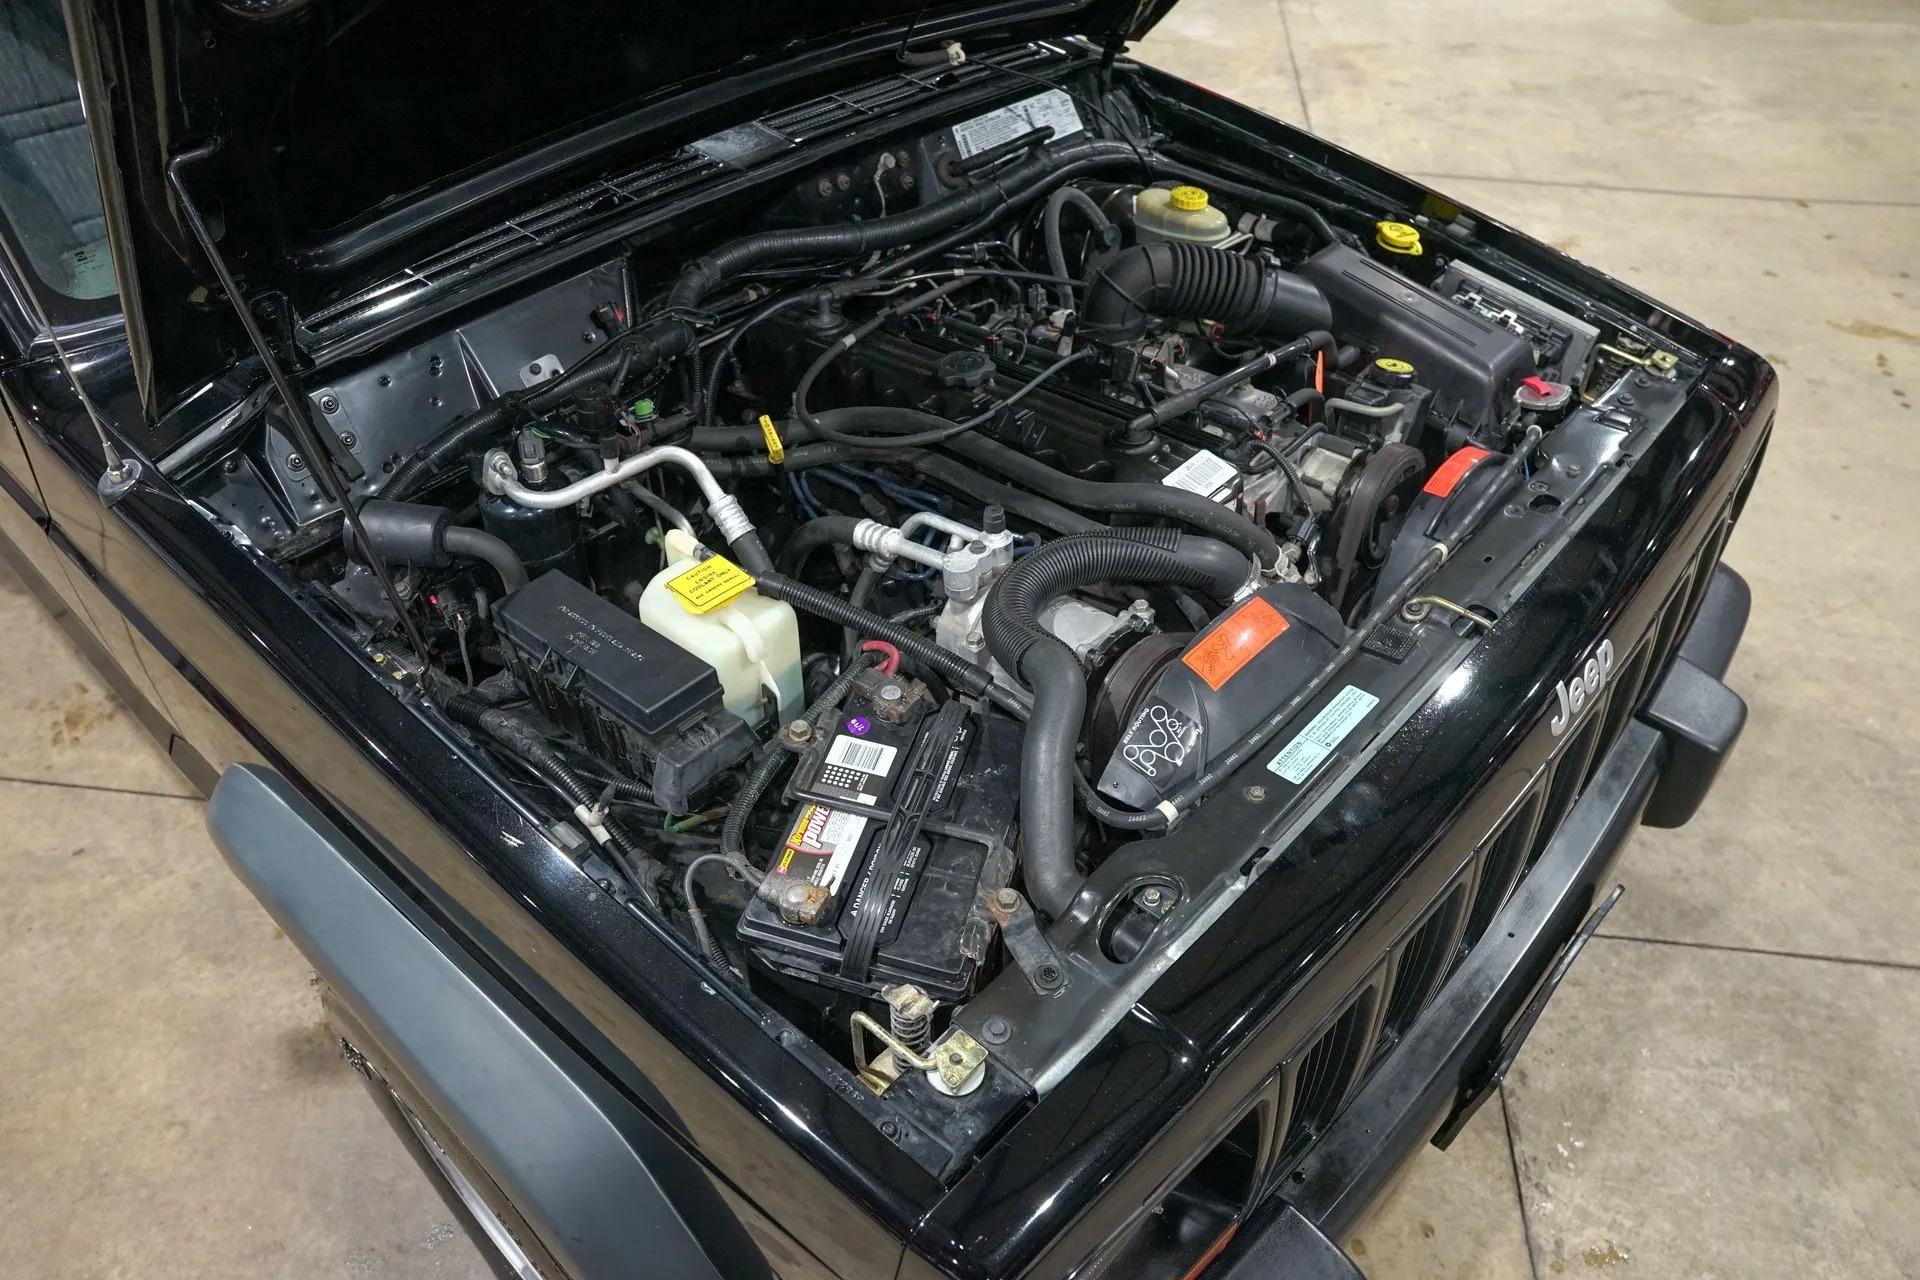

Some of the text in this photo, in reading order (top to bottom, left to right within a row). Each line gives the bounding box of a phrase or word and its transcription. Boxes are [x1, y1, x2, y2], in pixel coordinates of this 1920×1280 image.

[686, 564, 712, 581] CAUTION
[689, 568, 731, 593] COOLANT ONLY
[1551, 639, 1614, 737] Jeep
[1122, 707, 1150, 744] BELT ROUTING
[1276, 741, 1302, 766] ATTENTION
[802, 805, 831, 850] POWE
